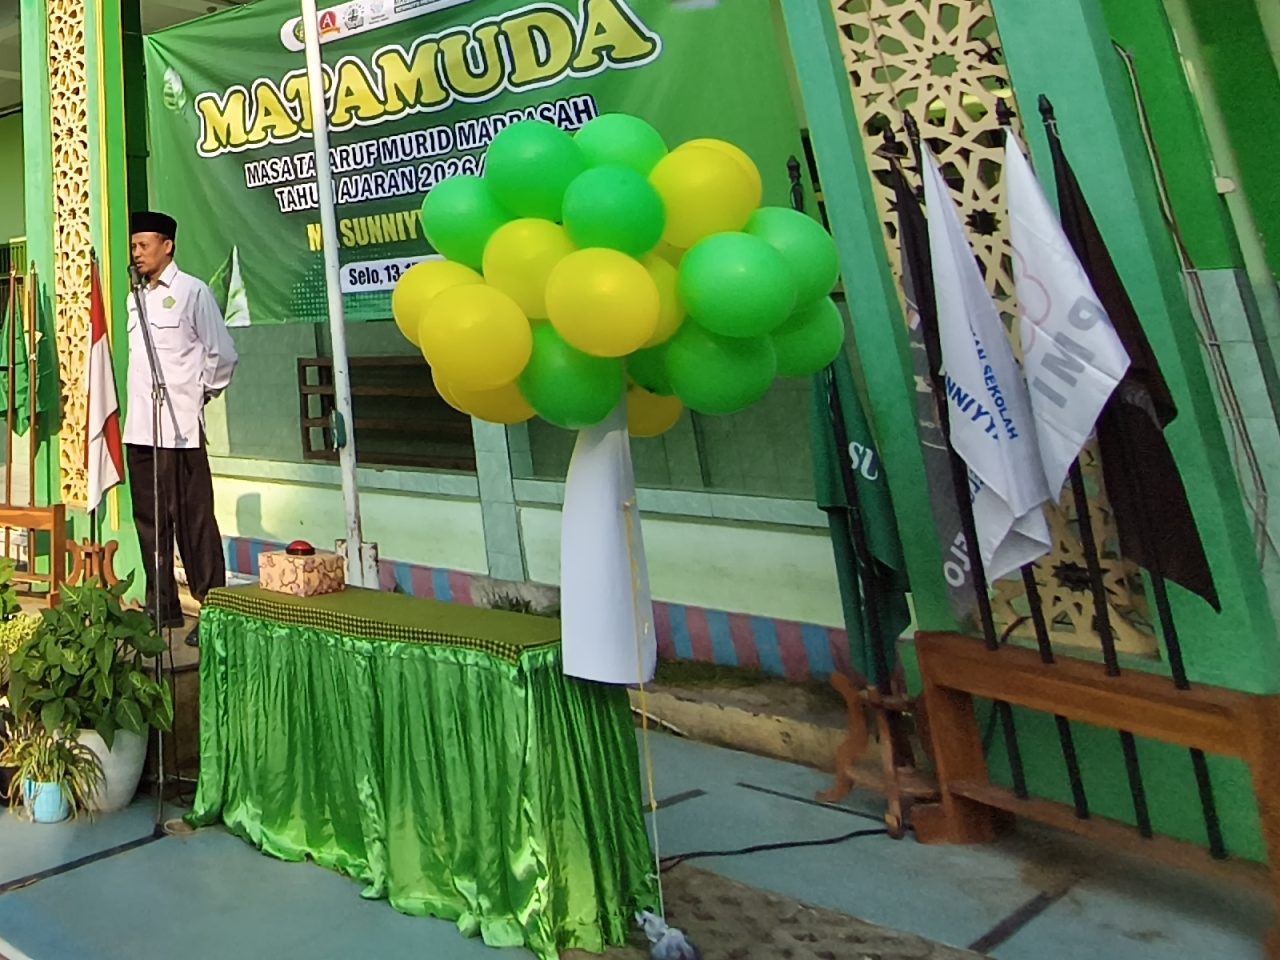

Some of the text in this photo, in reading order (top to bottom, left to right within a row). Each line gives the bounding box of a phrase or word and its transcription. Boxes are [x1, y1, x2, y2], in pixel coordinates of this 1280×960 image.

[246, 157, 293, 186] MASA
[380, 126, 452, 164] MURID
[275, 179, 337, 212] TAHU
[338, 166, 414, 203] AJARAN
[349, 266, 383, 286] Selo,
